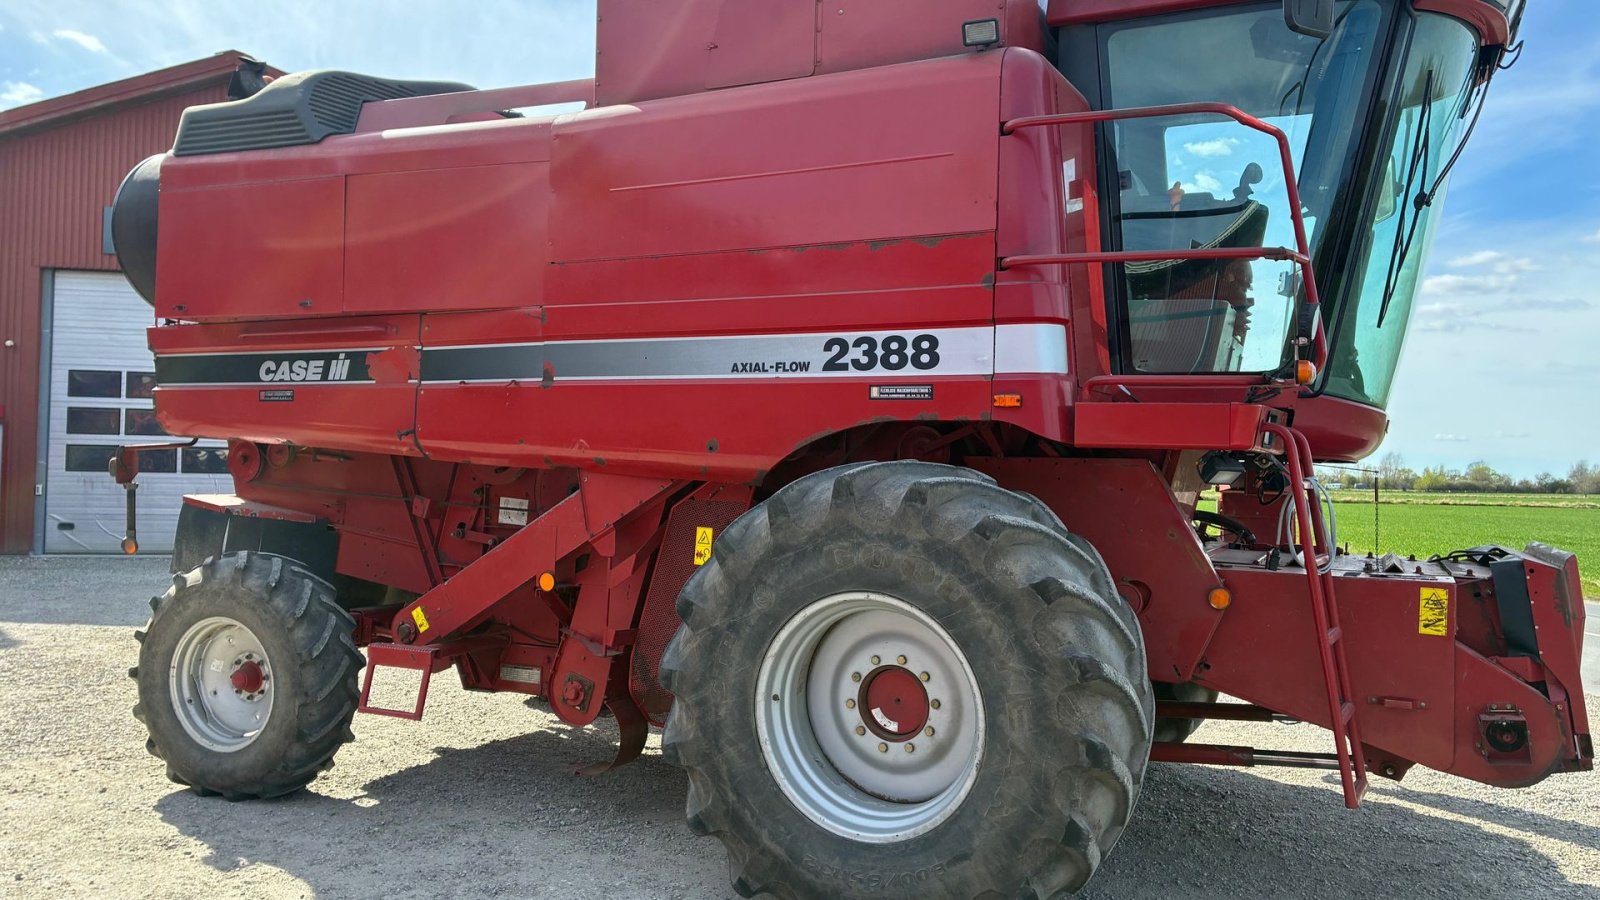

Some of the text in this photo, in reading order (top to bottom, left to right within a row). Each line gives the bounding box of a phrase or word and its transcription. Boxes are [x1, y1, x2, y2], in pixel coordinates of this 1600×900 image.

[731, 334, 940, 373] AXIAL-FLOW 2388
[259, 359, 324, 382] CASE
